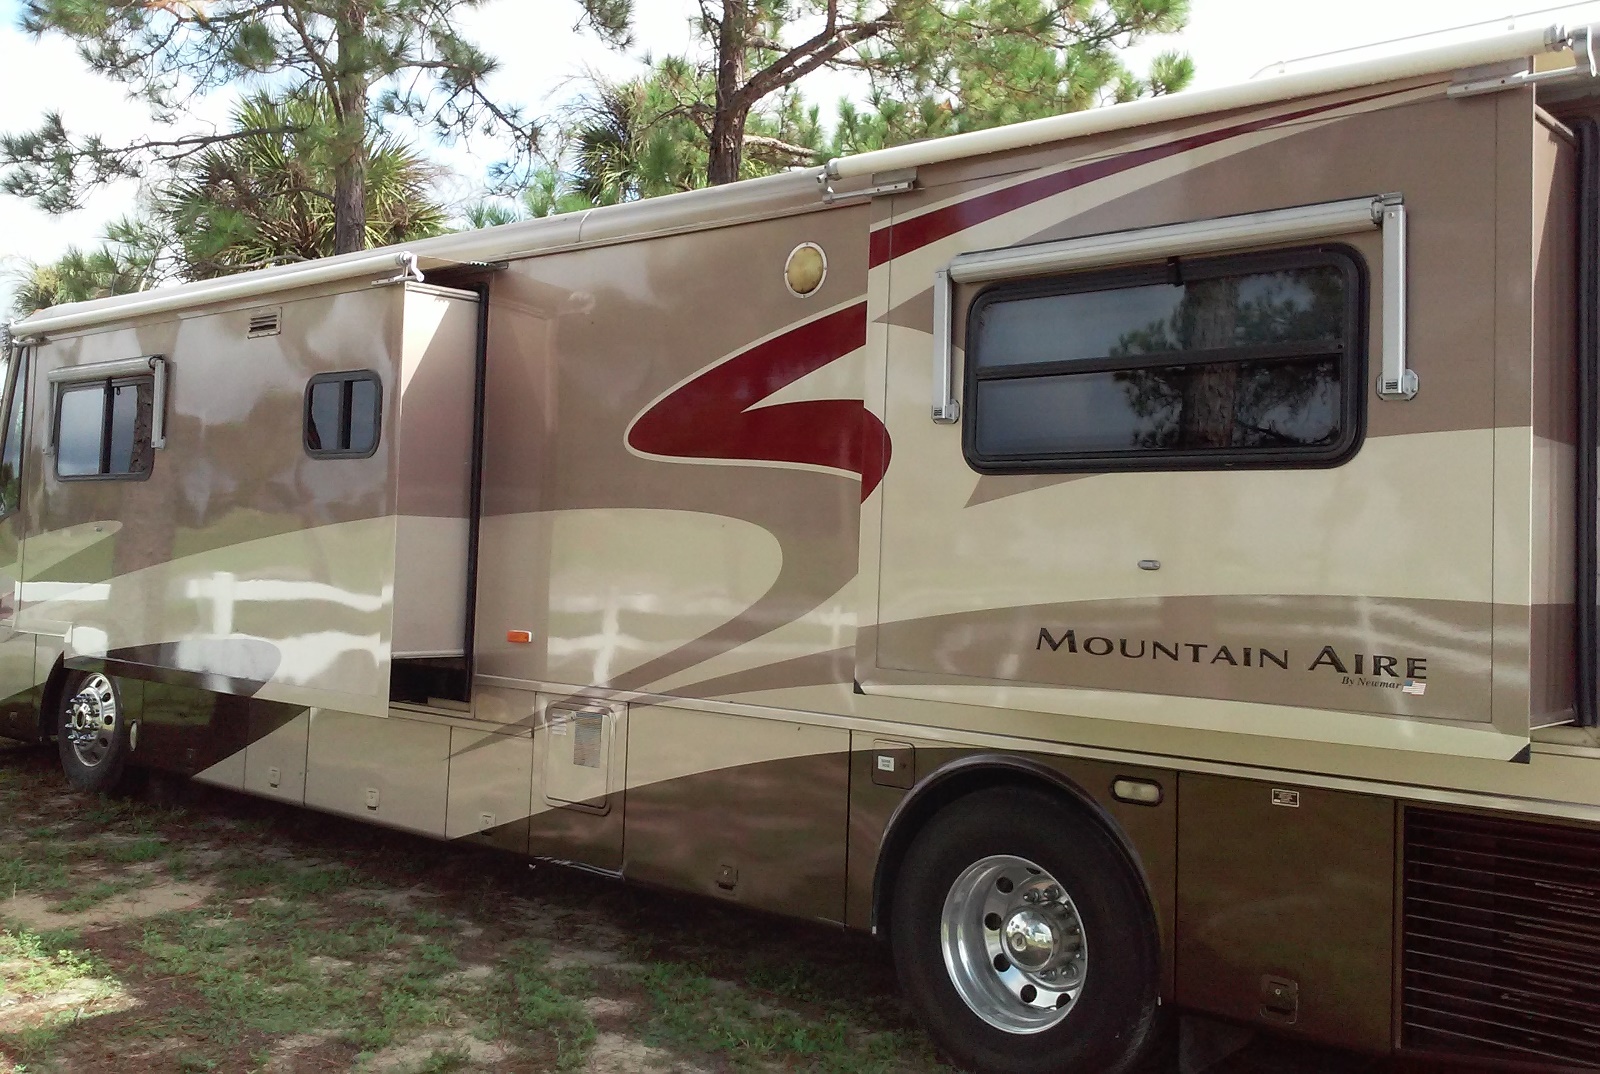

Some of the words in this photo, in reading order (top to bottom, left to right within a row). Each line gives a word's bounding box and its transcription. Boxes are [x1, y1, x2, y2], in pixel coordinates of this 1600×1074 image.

[1036, 627, 1288, 670] MOUNTAIN
[1308, 645, 1427, 680] AIRE
[1341, 676, 1354, 686] By
[1358, 677, 1402, 689] Newmar
